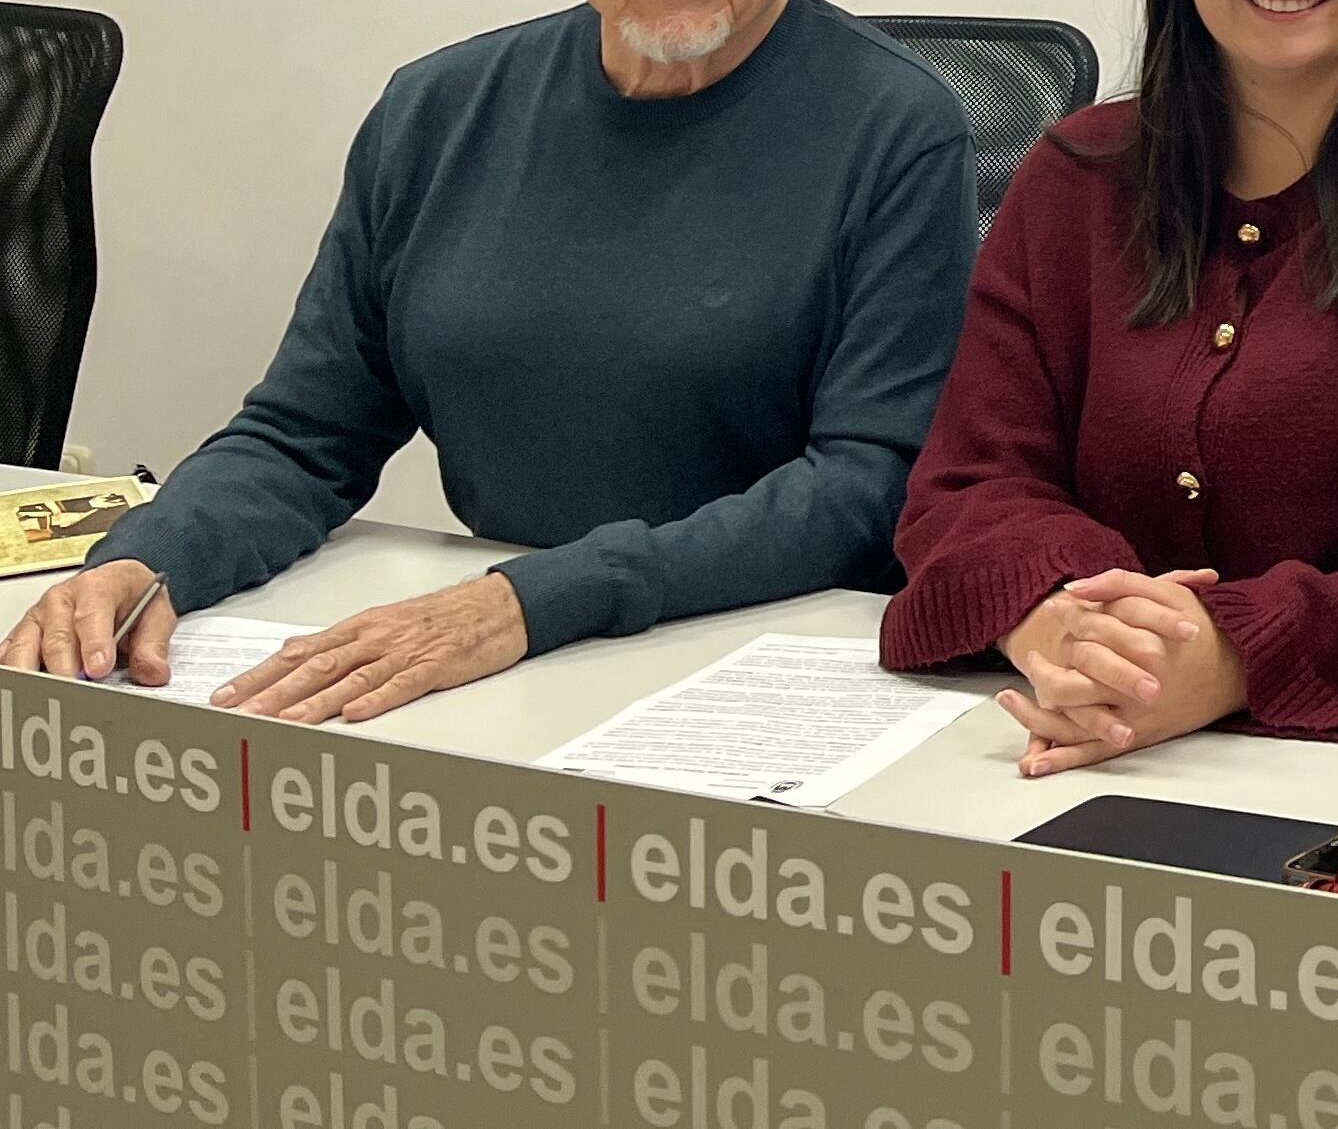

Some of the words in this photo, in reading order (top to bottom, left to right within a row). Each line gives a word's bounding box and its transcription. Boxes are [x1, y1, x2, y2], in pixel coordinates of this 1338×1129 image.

[0, 688, 221, 812] lda.es
[270, 752, 573, 883] elda.es
[630, 818, 975, 954] elda.es
[2, 790, 224, 917] lda.es
[273, 859, 575, 994] elda.es
[631, 932, 974, 1072] elda.es
[5, 892, 226, 1021] lda.es
[276, 966, 576, 1104] elda.es
[7, 993, 229, 1125] lda.es
